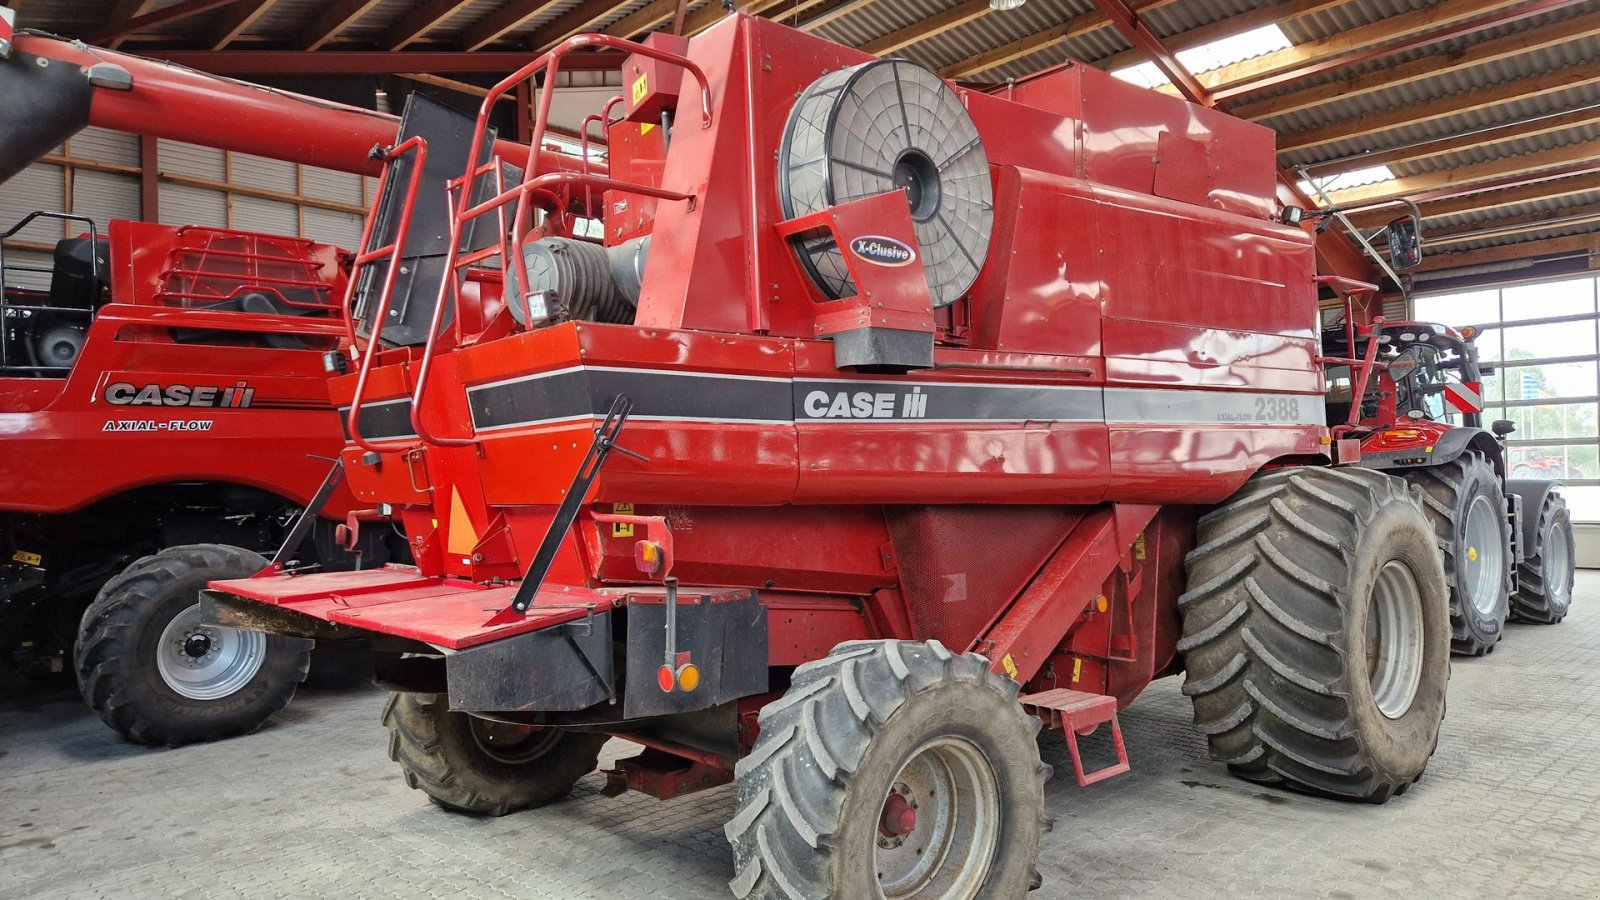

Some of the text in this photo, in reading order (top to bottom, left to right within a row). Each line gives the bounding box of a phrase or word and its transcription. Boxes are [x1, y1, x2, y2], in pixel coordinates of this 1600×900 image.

[857, 240, 909, 260] X-Clusive
[103, 382, 217, 407] CASE
[804, 391, 896, 418] CASE
[1255, 397, 1299, 421] 2388
[102, 420, 214, 432] AXIAL-FLOW
